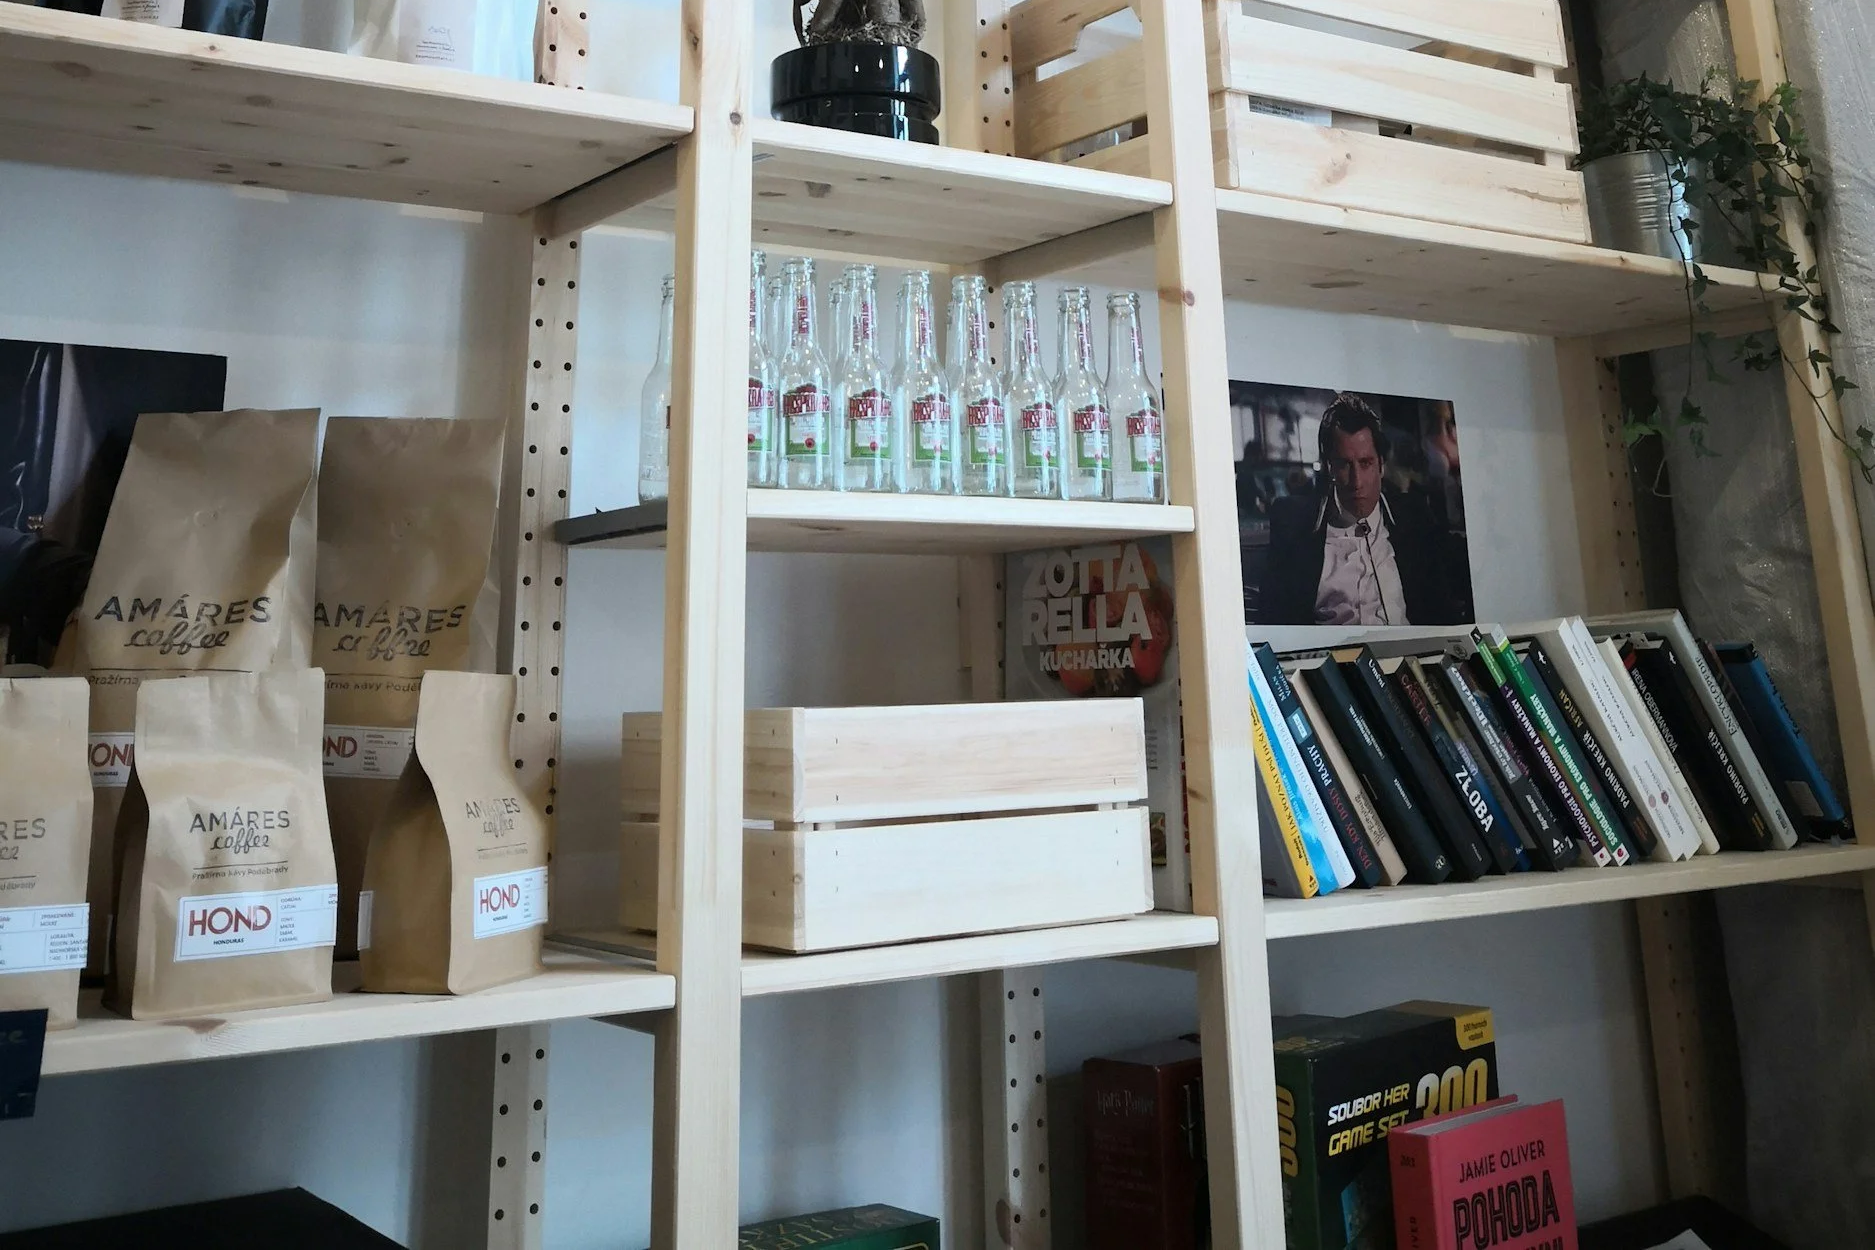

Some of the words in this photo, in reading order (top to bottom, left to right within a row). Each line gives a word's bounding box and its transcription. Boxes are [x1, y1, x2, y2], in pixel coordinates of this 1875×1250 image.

[1022, 542, 1150, 599] ZOTTA
[94, 594, 273, 626] AMÁRES
[1022, 591, 1152, 647] RELLA
[123, 621, 231, 656] coffee
[1039, 643, 1136, 672] KUCHAŘKA
[1365, 658, 1387, 688] Umění
[1629, 667, 1649, 693] IRENA
[1527, 692, 1557, 737] MANAŽERY
[1689, 654, 1741, 736] ENCYKLOPEDIE
[1509, 697, 1537, 739] MANAŽERY
[88, 742, 135, 768] ON
[1305, 742, 1334, 787] PRACHY
[1536, 742, 1563, 782] EKONOMY
[1556, 742, 1583, 782] EKONOMY
[1578, 727, 1609, 770] KREJČÍŘ
[1703, 726, 1731, 766] KREJČÍŘ
[1556, 779, 1572, 798] PRO
[1577, 780, 1593, 800] PRO
[1601, 765, 1632, 809] PADRINO
[1723, 763, 1751, 805] PADRINO
[189, 806, 291, 833] AMÁRES
[465, 797, 521, 819] AMRES
[1566, 795, 1600, 848] PSYCHOLOGIE
[1587, 797, 1619, 846] SOCIOLOGIE
[0, 817, 47, 842] RES
[210, 827, 270, 855] coffee
[479, 883, 521, 915] HOND
[188, 904, 272, 937] HOND
[213, 937, 245, 946] HONDURAS
[1327, 1091, 1382, 1127] SOUBOR
[1383, 1083, 1411, 1107] HER
[1415, 1057, 1488, 1119] 300
[1328, 1121, 1375, 1157] GAME
[1376, 1109, 1410, 1139] SET
[1459, 1153, 1496, 1183] JAMIE
[1500, 1139, 1546, 1169] OLIVER
[1453, 1169, 1561, 1250] POHODA
